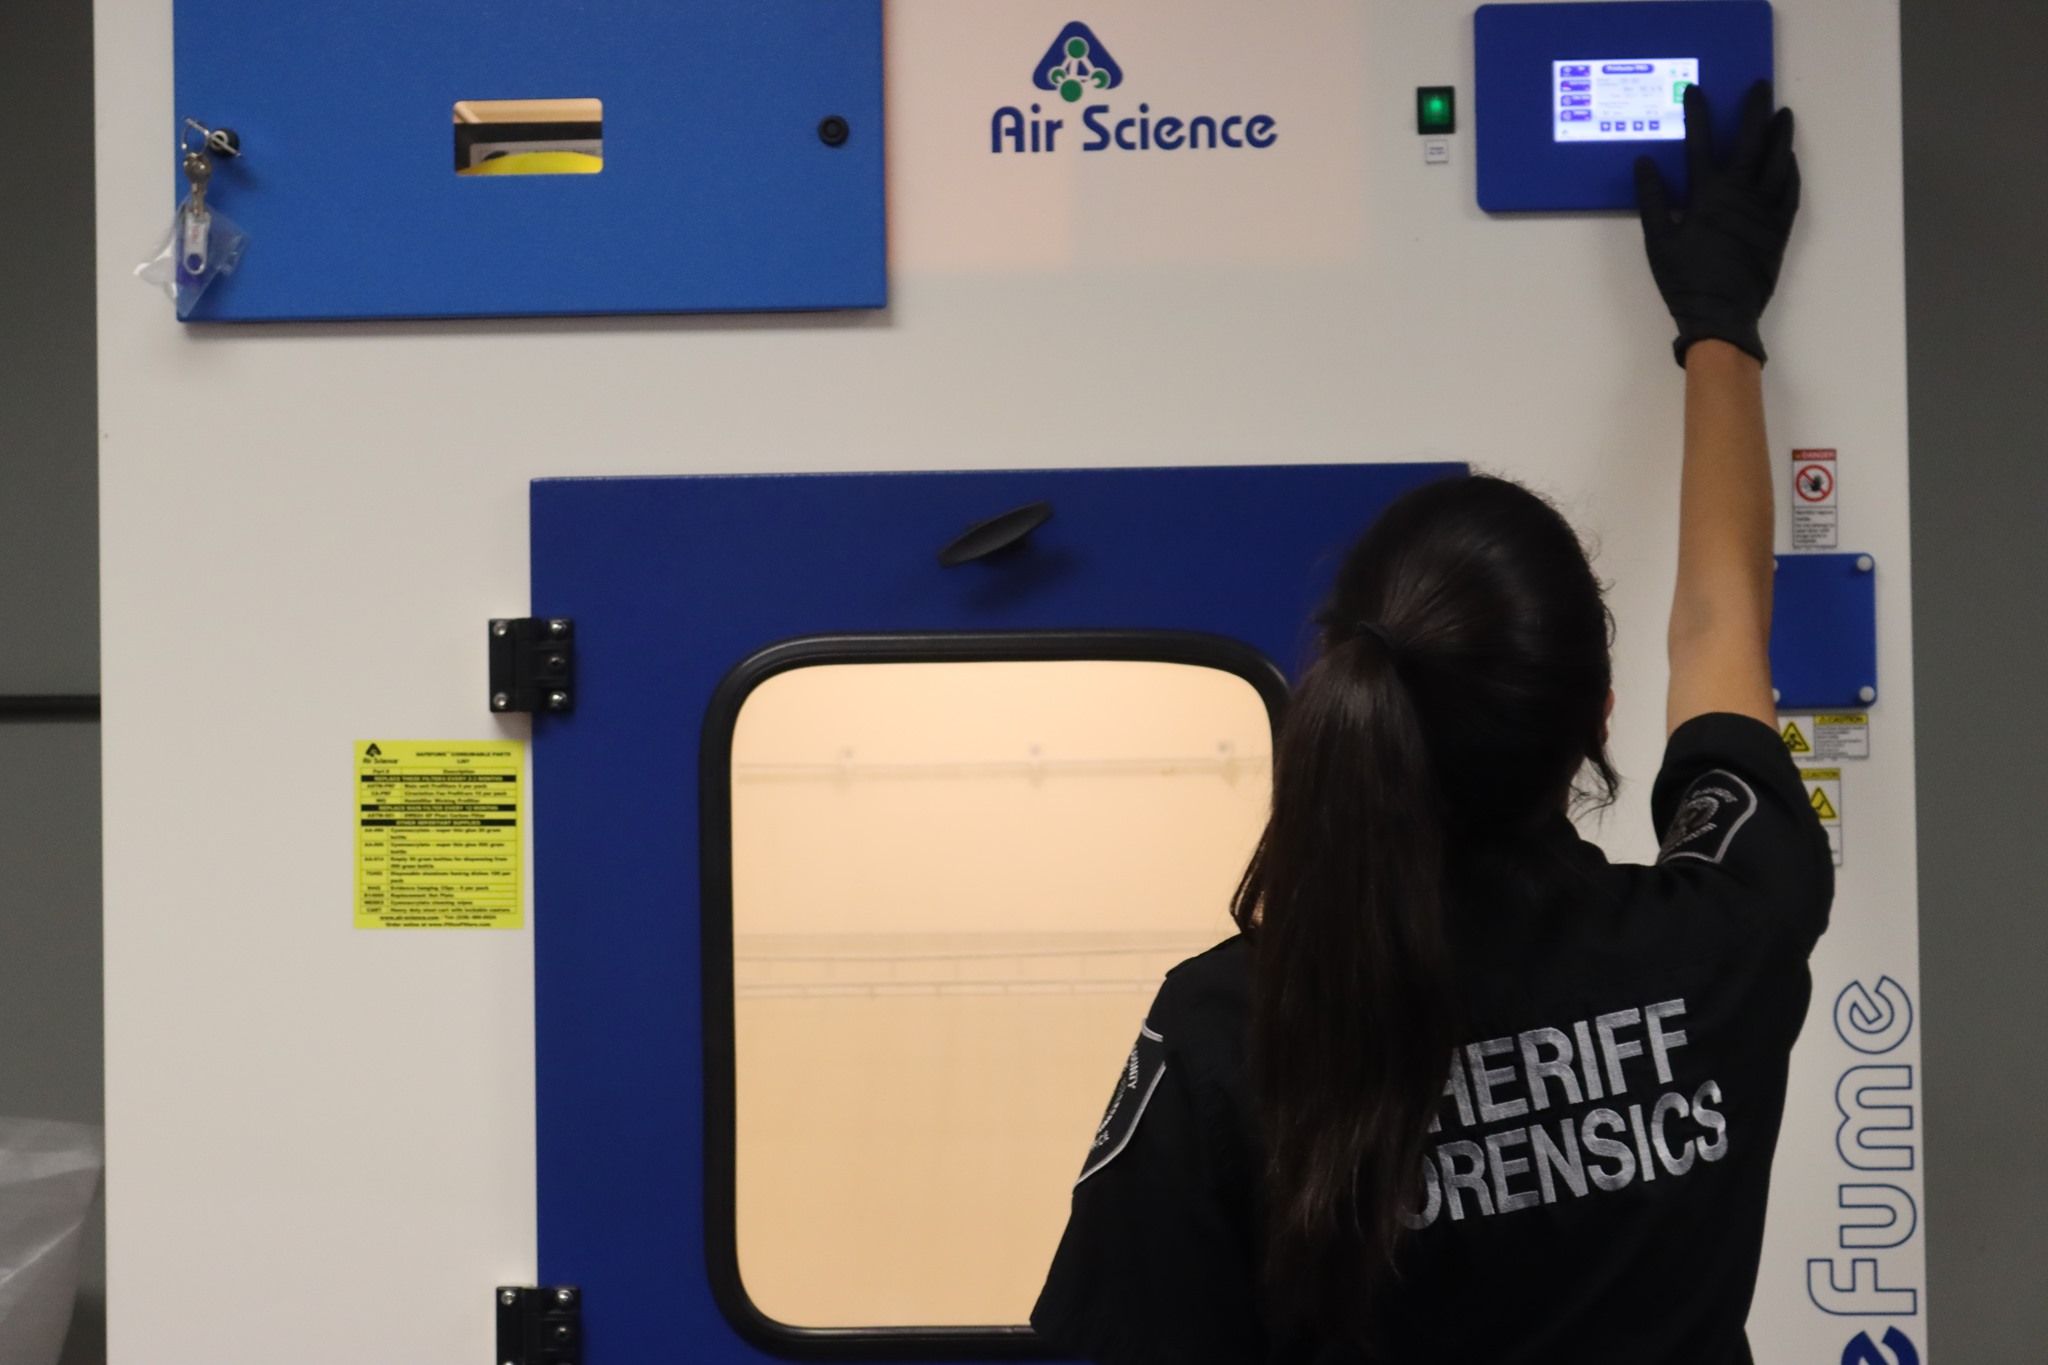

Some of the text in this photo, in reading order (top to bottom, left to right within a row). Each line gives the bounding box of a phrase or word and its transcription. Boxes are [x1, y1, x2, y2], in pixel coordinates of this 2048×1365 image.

[991, 102, 1278, 153] Air Science
[1428, 998, 1688, 1134] HERIFF
[1399, 1080, 1728, 1230] ORENSICS
